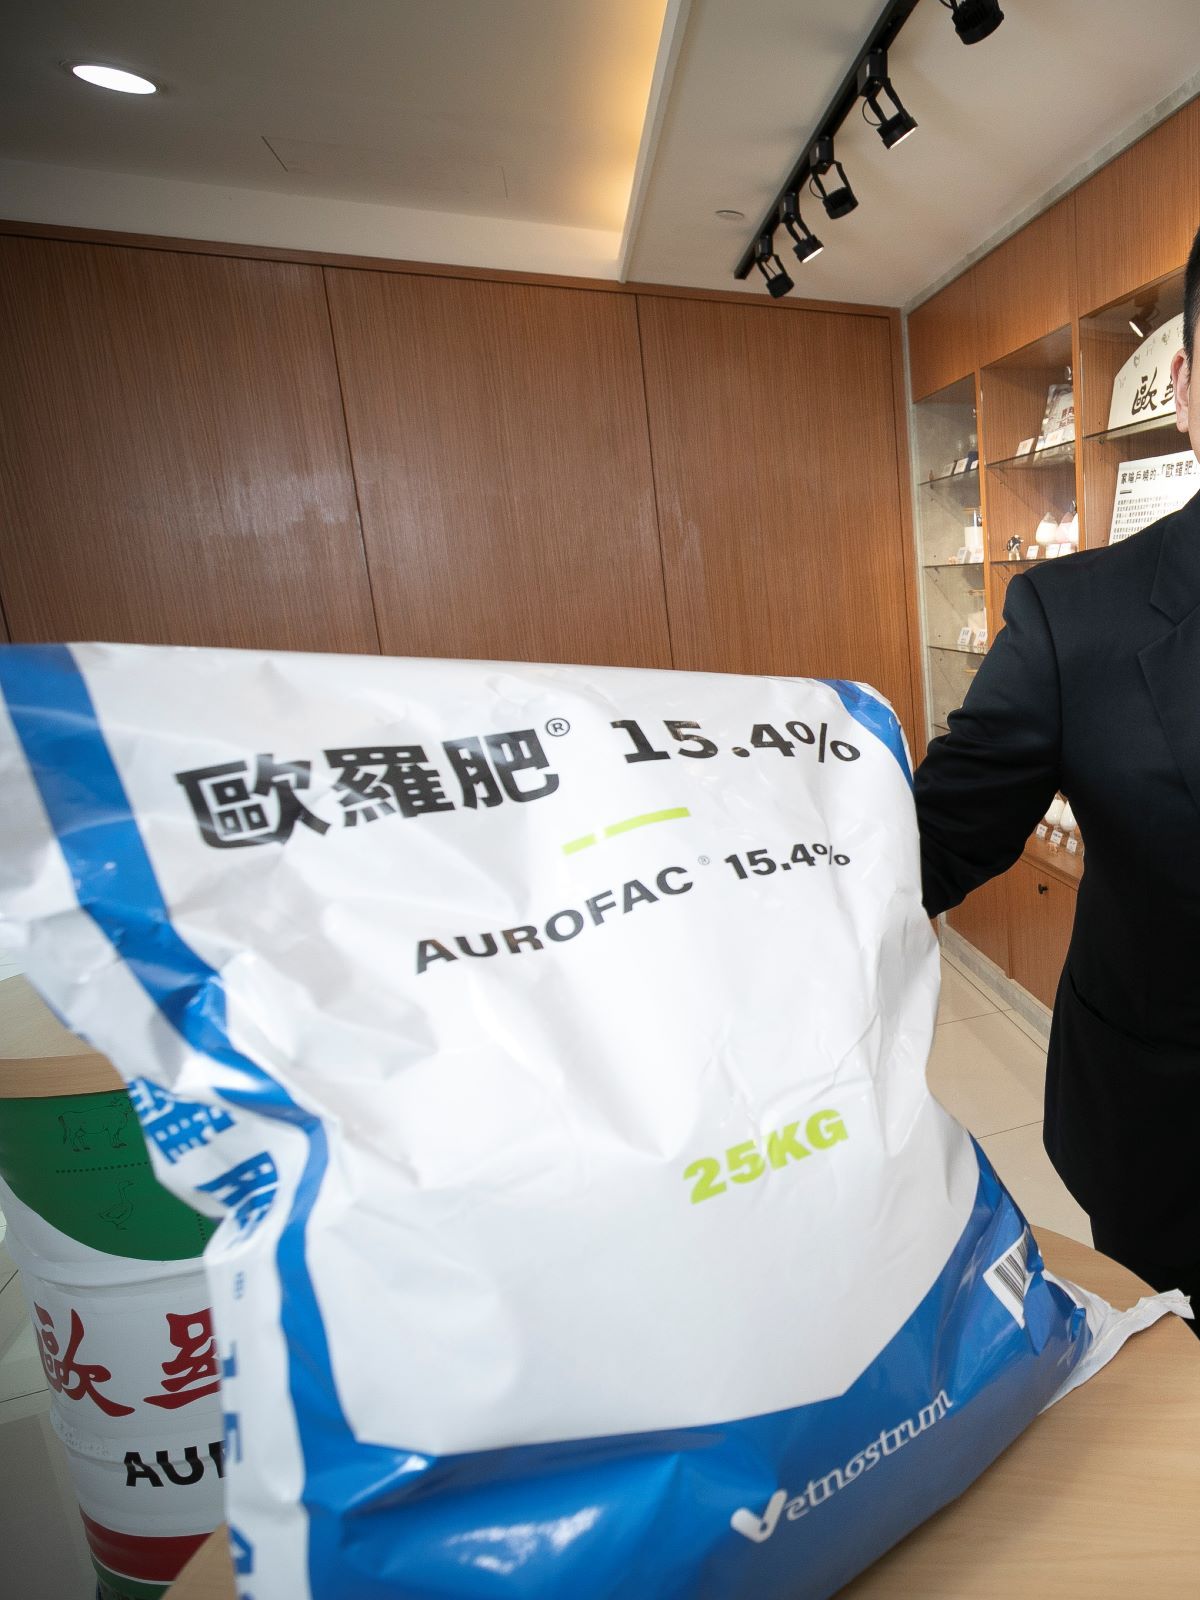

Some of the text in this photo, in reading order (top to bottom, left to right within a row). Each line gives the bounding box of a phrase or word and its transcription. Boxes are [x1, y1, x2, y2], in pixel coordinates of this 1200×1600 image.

[611, 719, 862, 764] 15.4%
[724, 842, 851, 881] 15.4%
[682, 1108, 849, 1205] 25KG
[123, 1438, 228, 1489] AU
[730, 1389, 954, 1544] Vetnostrum
